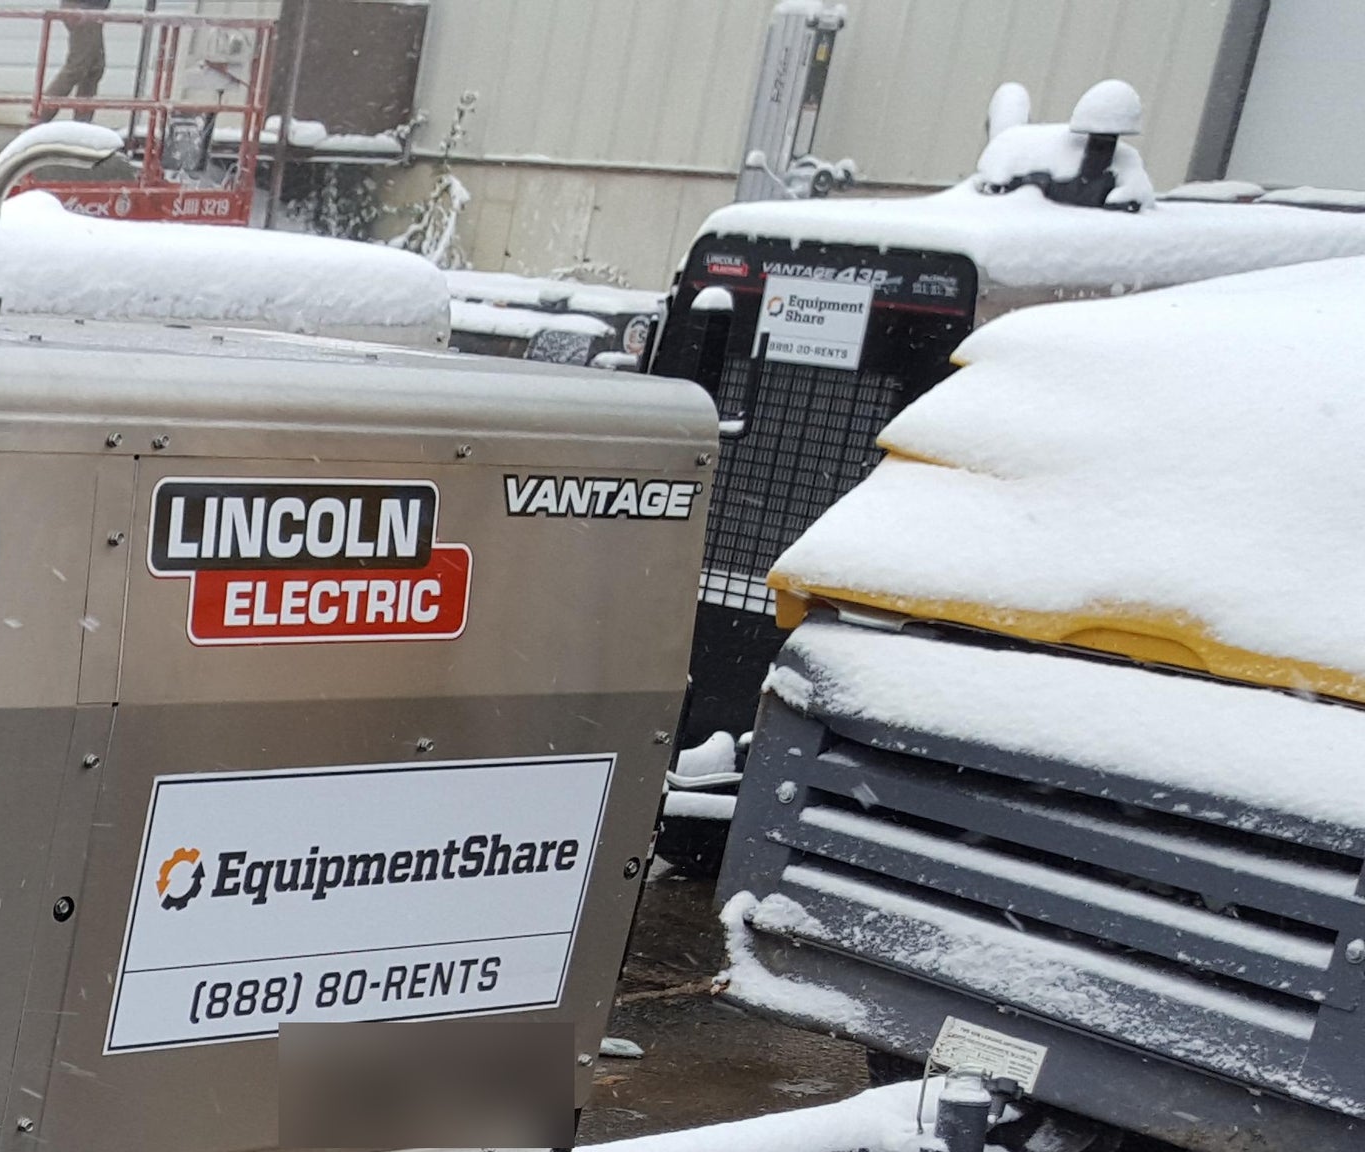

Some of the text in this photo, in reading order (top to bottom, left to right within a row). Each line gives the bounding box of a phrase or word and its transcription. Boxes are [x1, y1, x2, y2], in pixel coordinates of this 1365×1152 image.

[200, 198, 230, 217] 3219
[762, 261, 837, 280] VANTAGE
[785, 309, 825, 326] Share
[788, 294, 864, 315] Equipment
[505, 475, 696, 519] VANTAGE
[167, 496, 421, 559] LINCOLN
[222, 579, 443, 627] ELECTRIC
[210, 834, 579, 905] EquipmentShare
[189, 956, 502, 1024] (888) 80-RENTS
